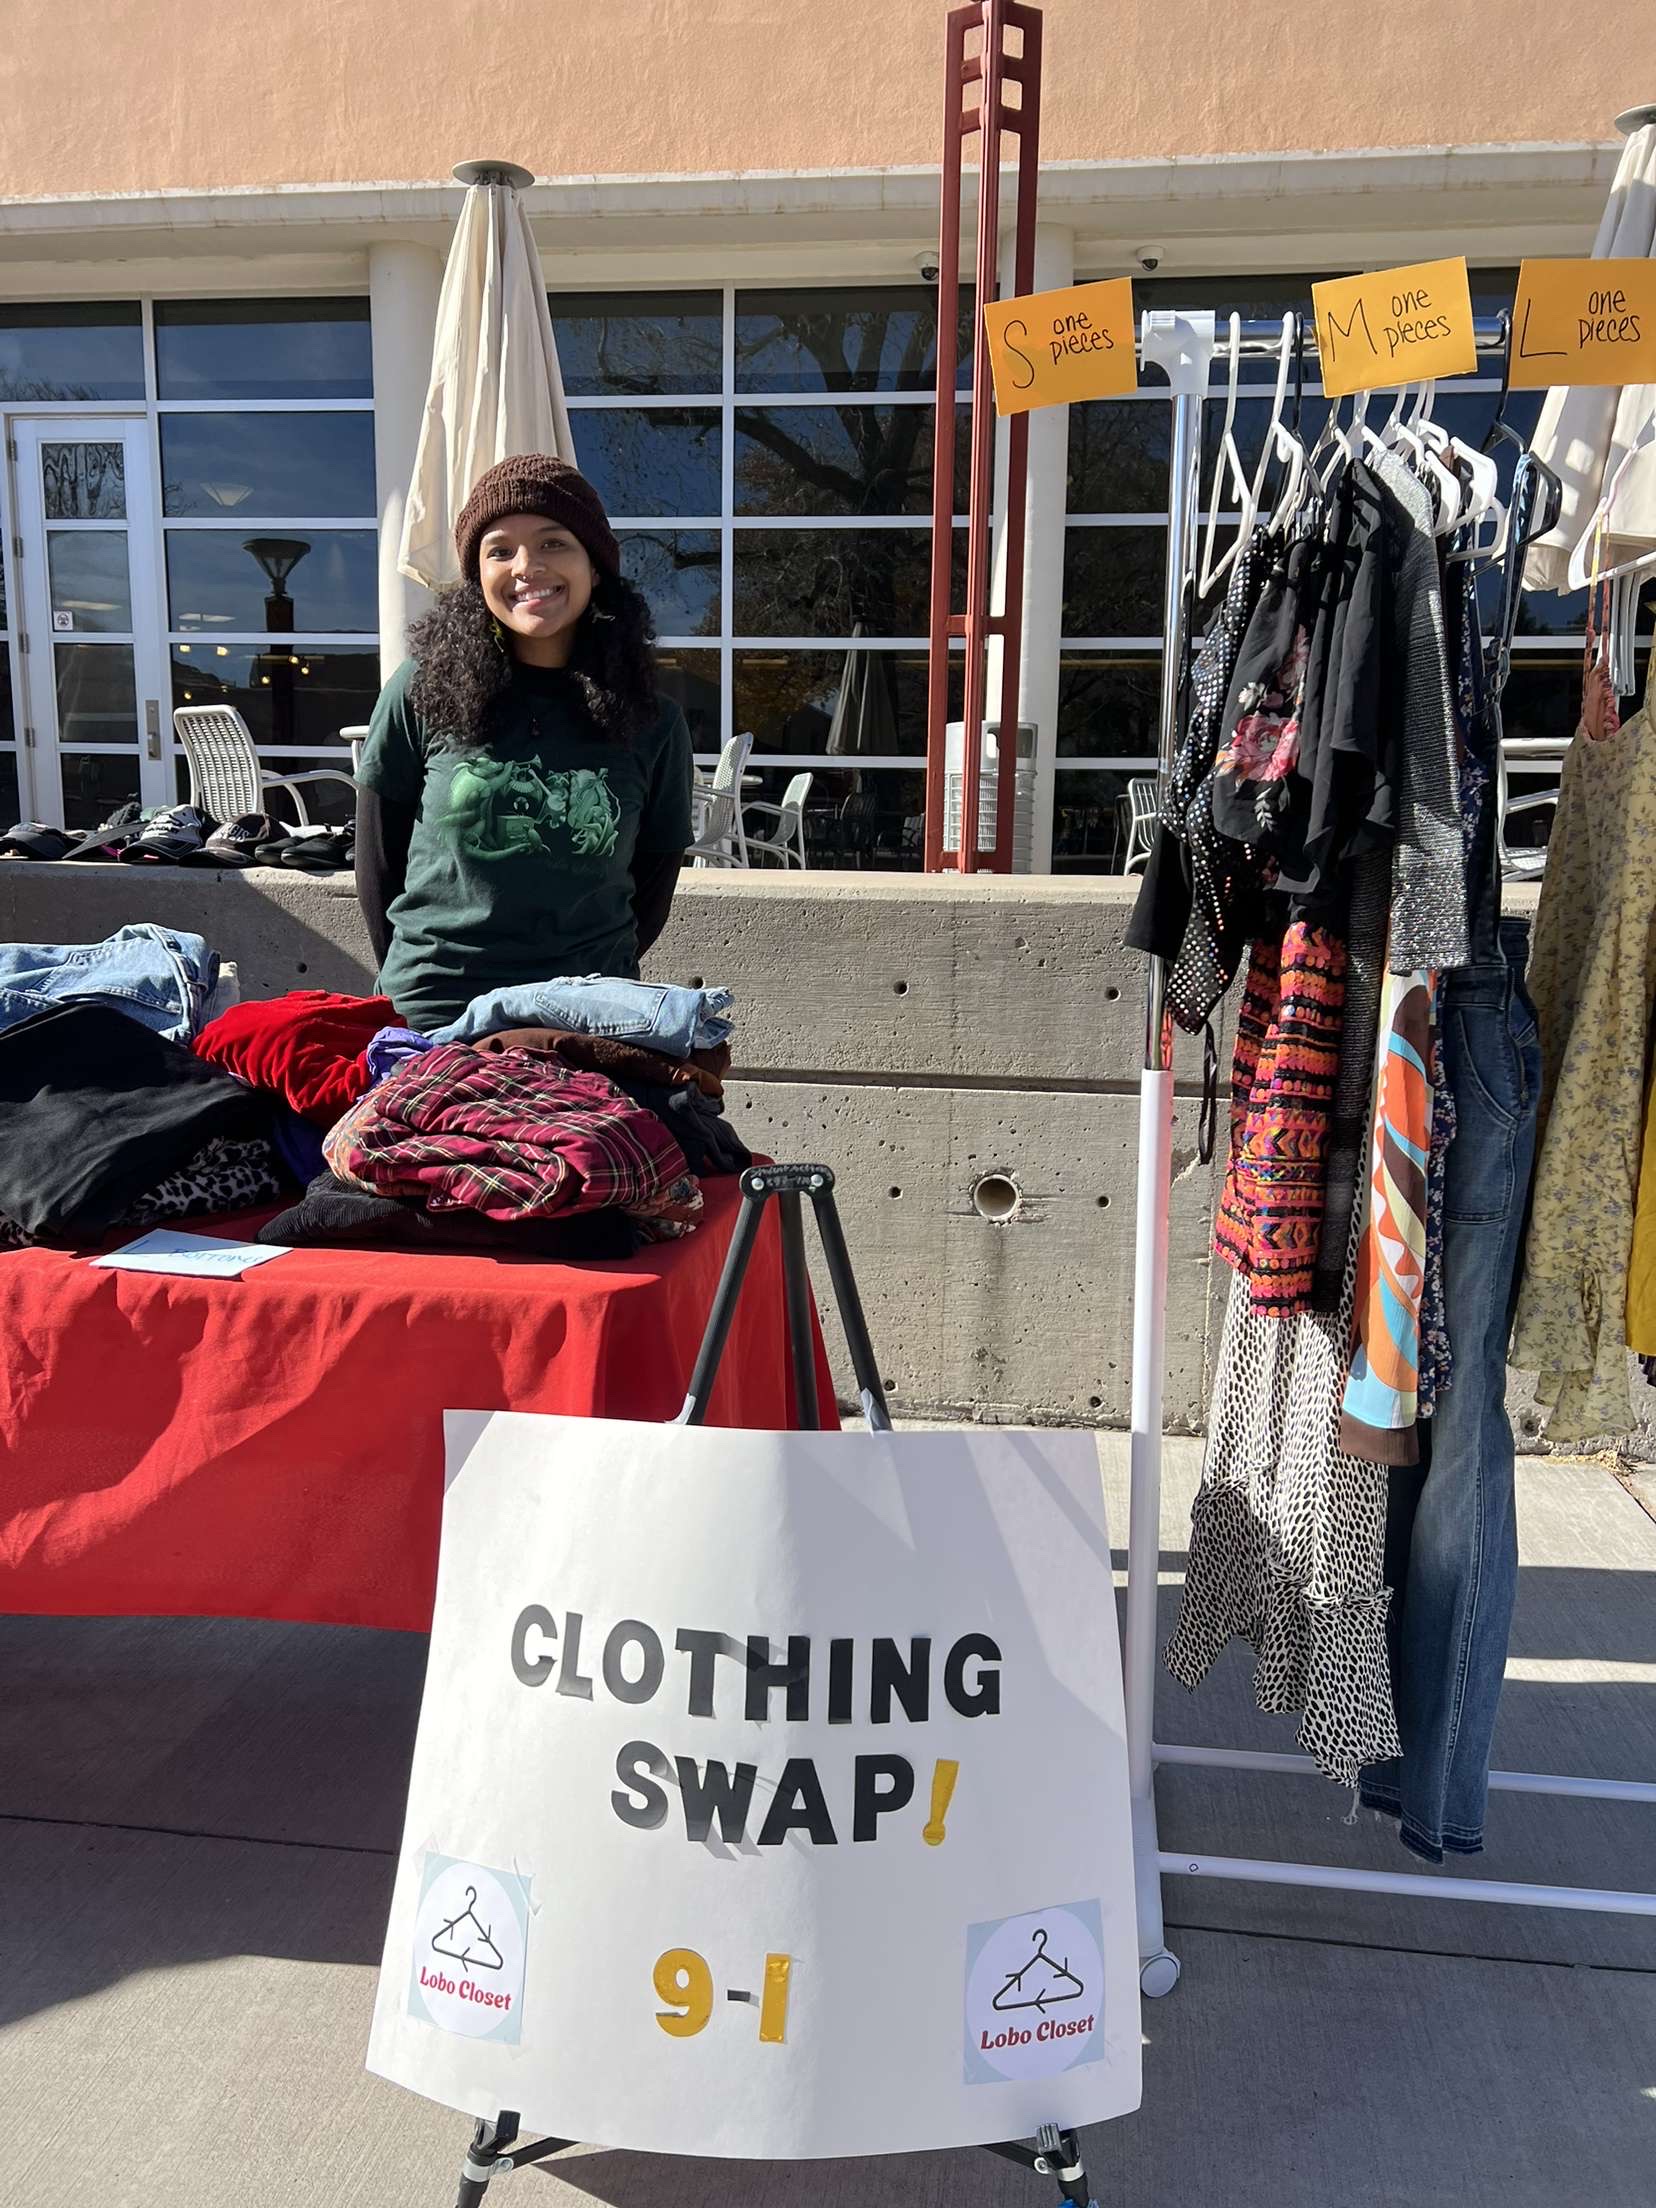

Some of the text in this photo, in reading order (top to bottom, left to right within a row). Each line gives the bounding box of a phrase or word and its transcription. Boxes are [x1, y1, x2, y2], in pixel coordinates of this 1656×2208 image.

[1003, 311, 1093, 390] S one
[1049, 328, 1115, 366] pieces
[1327, 289, 1433, 363] M one
[1383, 315, 1452, 358] pieces
[1519, 289, 1627, 358] L one
[1578, 314, 1641, 350] pieces
[510, 1603, 1003, 1725] CLOTHING
[610, 1739, 960, 1846] SWAP!
[419, 1965, 512, 2011] Lobo Closet
[652, 1947, 791, 2044] 9-1
[980, 2013, 1095, 2050] Lobo Closet
